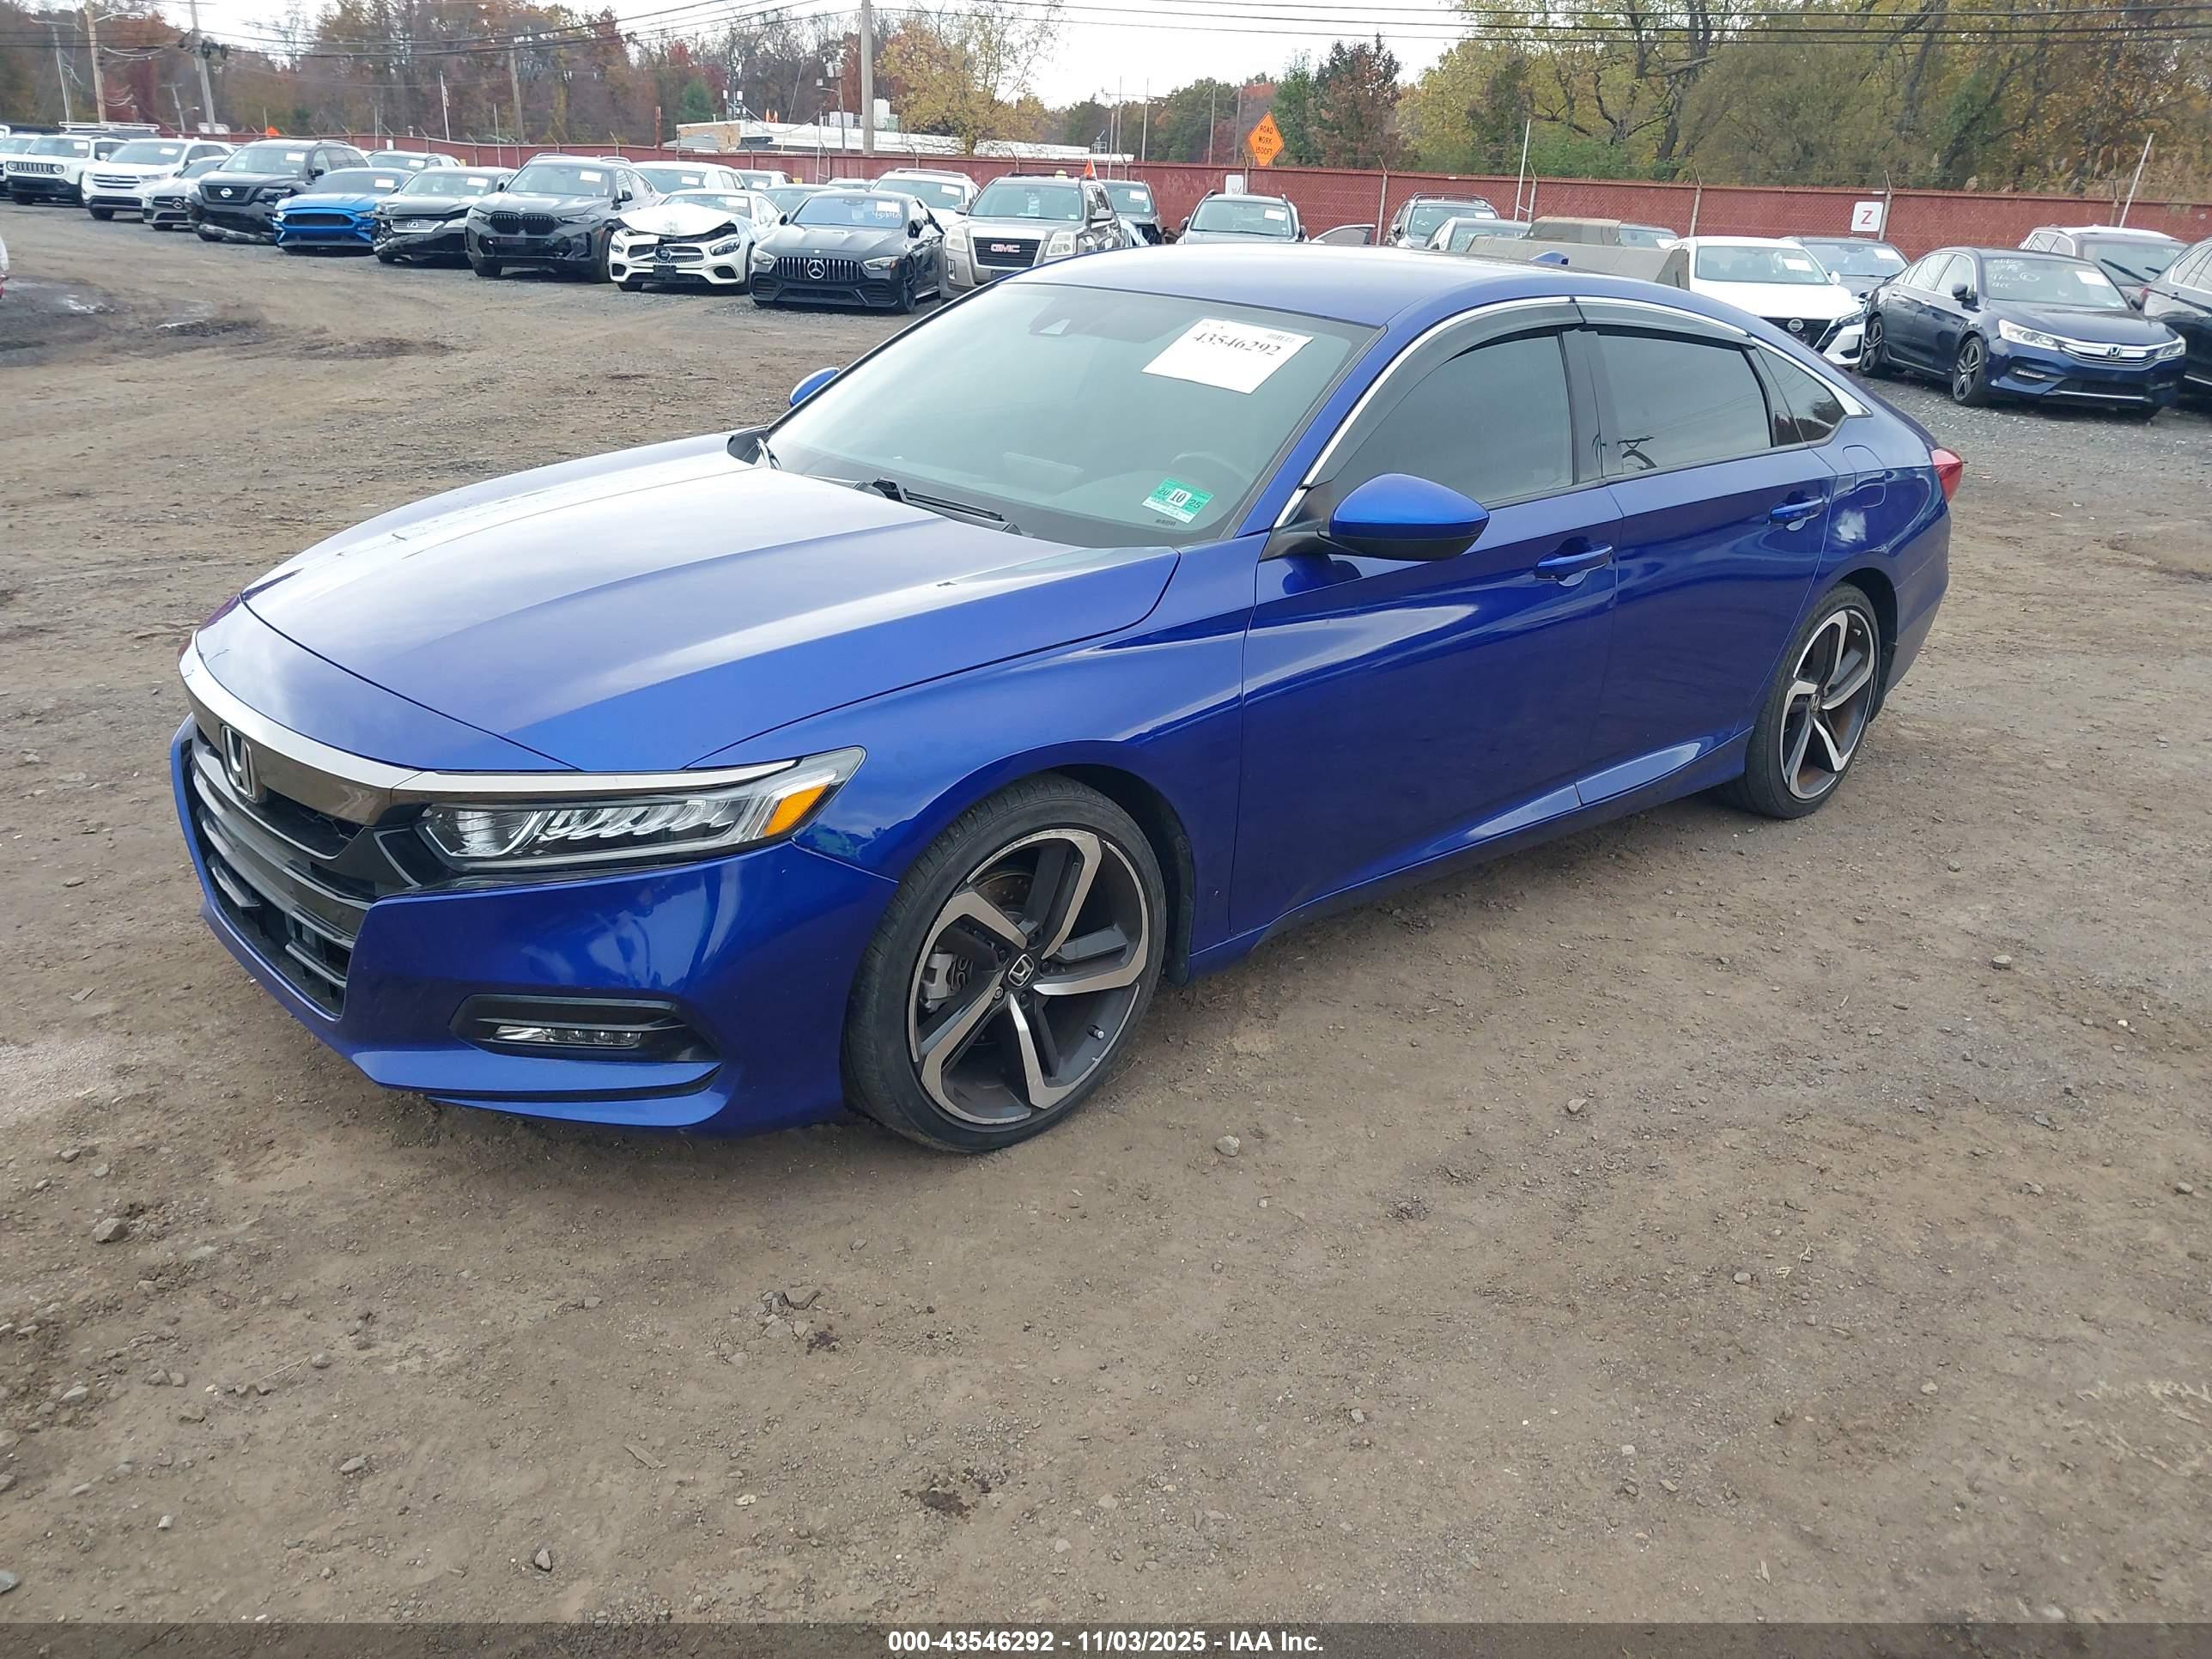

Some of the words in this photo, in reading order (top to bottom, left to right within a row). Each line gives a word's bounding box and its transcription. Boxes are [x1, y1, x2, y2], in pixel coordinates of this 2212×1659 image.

[1259, 125, 1273, 135] ROAD
[1258, 136, 1273, 145] WORK
[1861, 210, 1873, 225] Z
[990, 244, 1020, 253] GMC
[1193, 332, 1282, 356] 43546292
[1169, 490, 1187, 503] 10
[1188, 499, 1203, 509] 25
